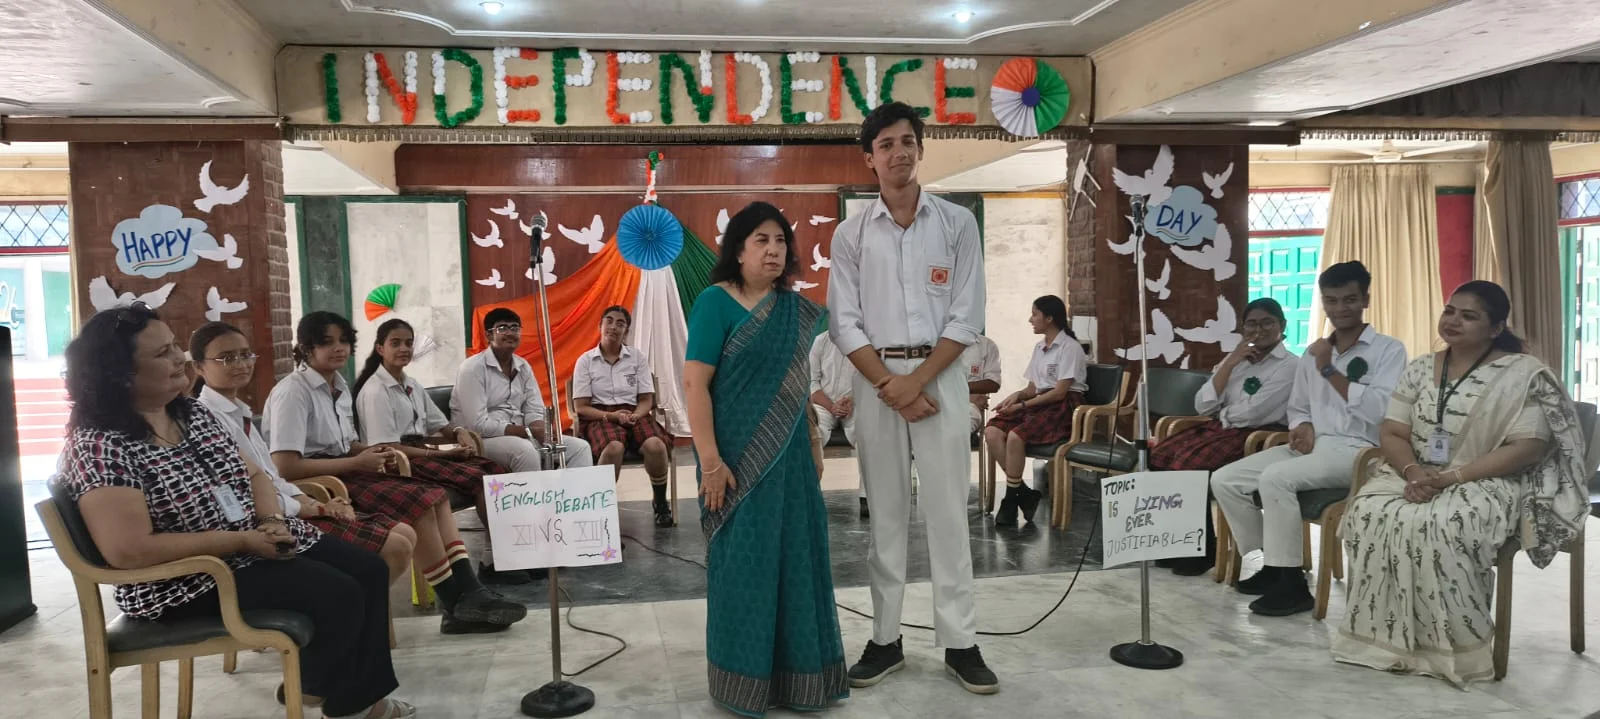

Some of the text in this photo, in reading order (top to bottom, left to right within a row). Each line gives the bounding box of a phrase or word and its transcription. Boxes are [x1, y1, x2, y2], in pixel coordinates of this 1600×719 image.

[323, 47, 977, 127] INDEPENDENCE
[1156, 205, 1202, 235] DAY
[122, 227, 191, 263] HAPPY
[502, 489, 616, 514] ENGLISH DEBATE
[1104, 479, 1135, 496] TOPIC:
[1108, 493, 1183, 518] IS LYING
[539, 518, 567, 546] VS
[1125, 512, 1154, 533] EVER
[1107, 528, 1204, 558] JUSTIFIABLE?
